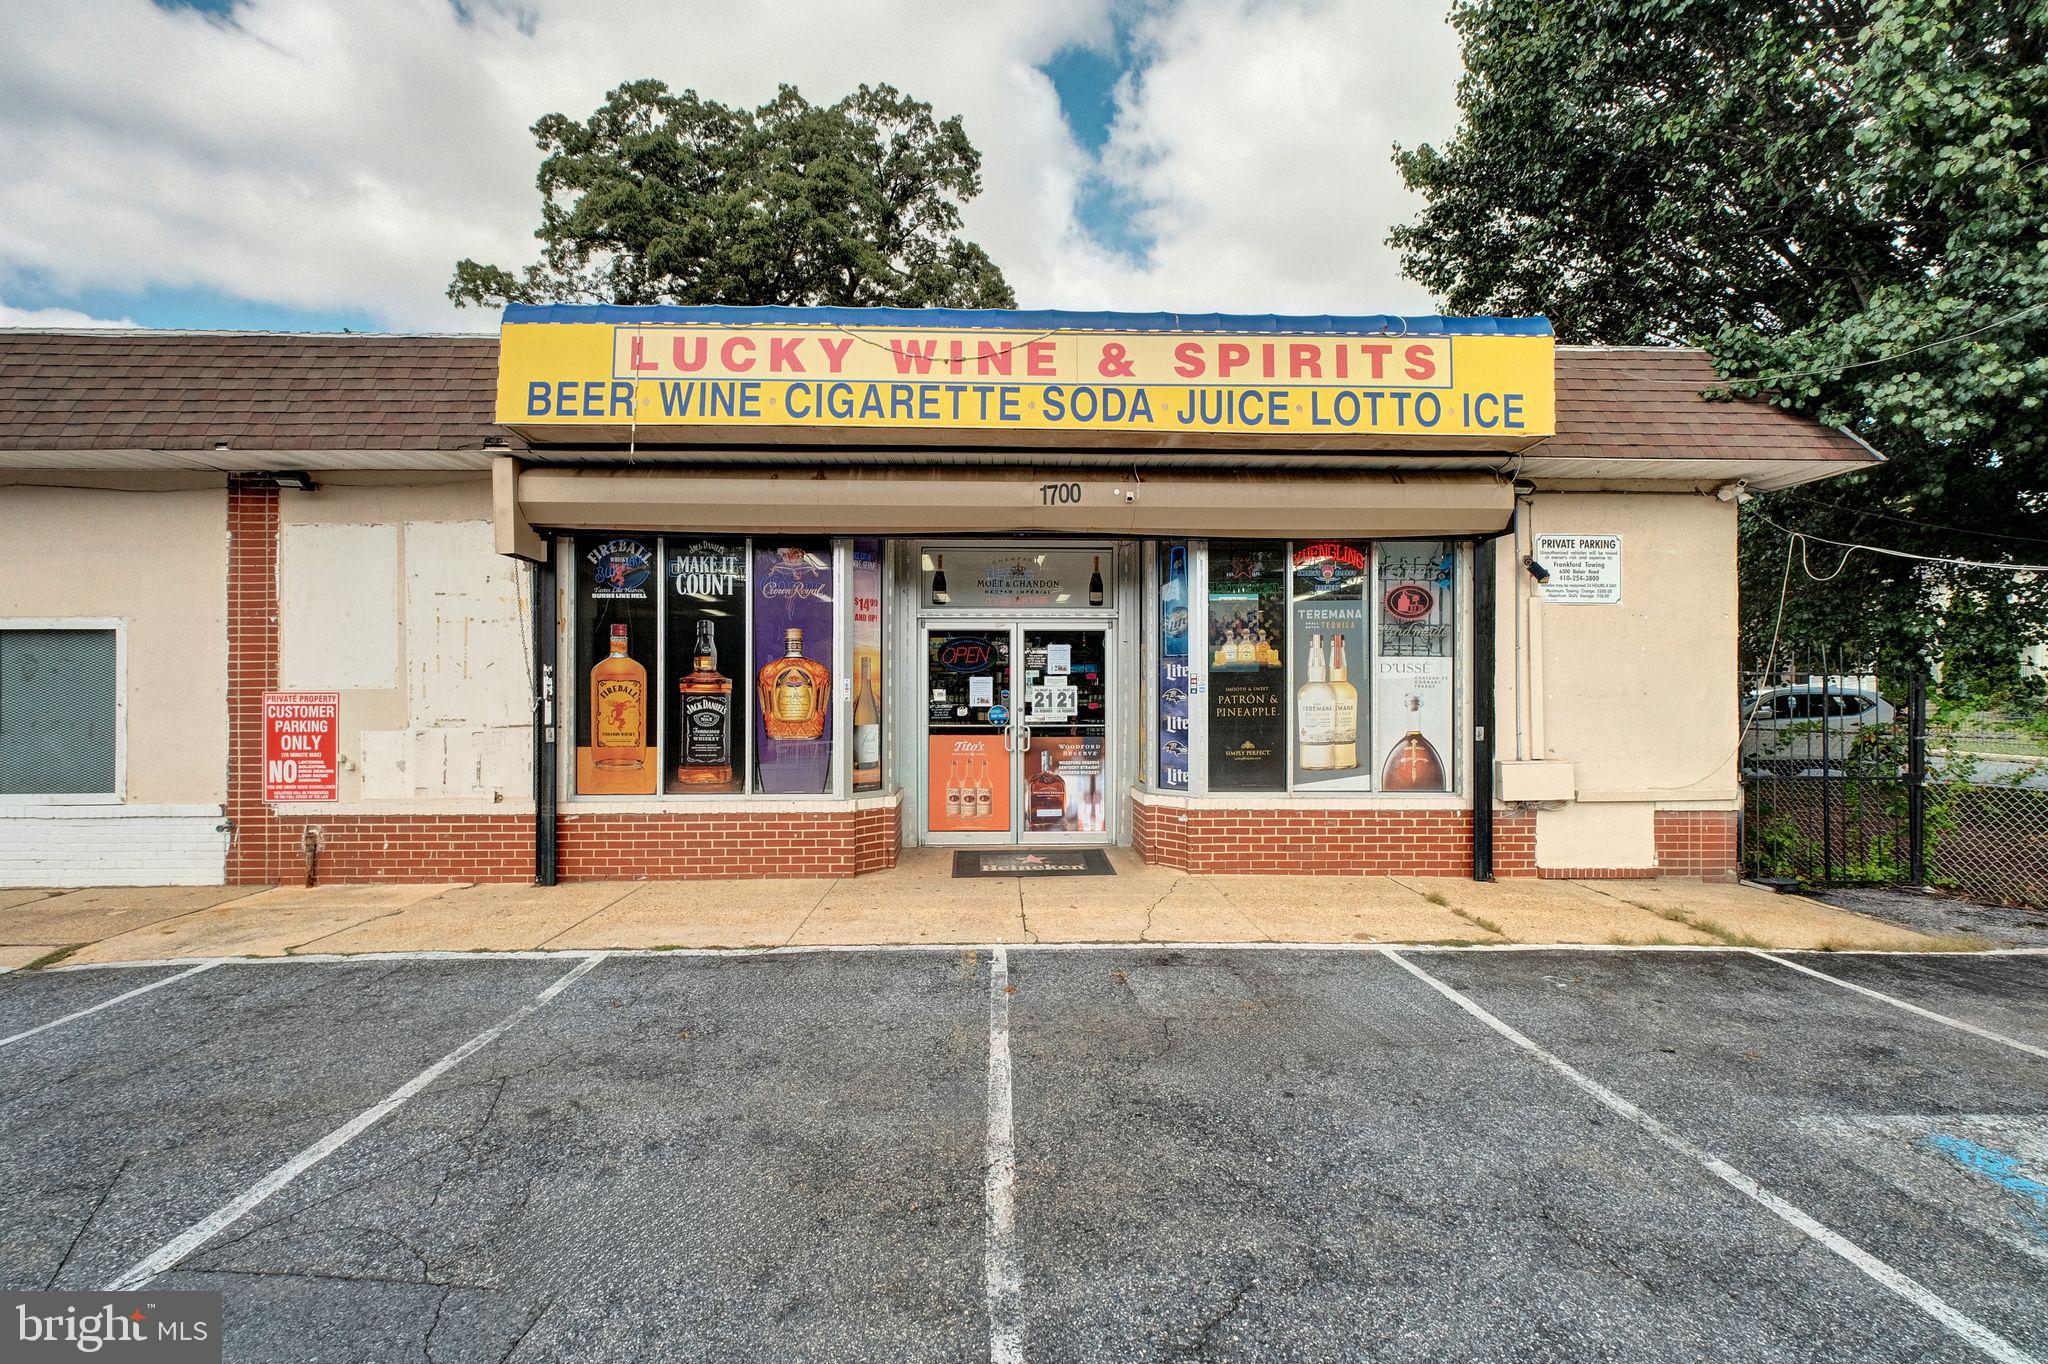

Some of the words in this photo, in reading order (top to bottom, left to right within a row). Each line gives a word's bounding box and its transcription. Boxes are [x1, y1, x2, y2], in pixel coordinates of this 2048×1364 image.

[630, 336, 855, 374] LUCKY
[890, 340, 1057, 376] WINE
[1098, 342, 1136, 378] &
[1173, 342, 1437, 380] SPIRITS
[527, 381, 634, 417] BEER
[659, 382, 762, 418] WINE
[784, 383, 1021, 421] CIGARETTE
[1042, 385, 1154, 423] SODA
[1176, 389, 1290, 426] JUICE
[1311, 390, 1442, 428] LOTTO
[1463, 392, 1525, 429] ICE
[1039, 483, 1082, 506] 1700
[1541, 539, 1576, 549] PRIVATE
[1579, 539, 1616, 549] PARKING
[586, 541, 653, 565] FIREBALL
[1293, 543, 1365, 569] YUENGLING
[677, 555, 718, 573] MAKE
[720, 556, 738, 573] IT
[676, 573, 735, 596] COUNT
[763, 582, 792, 599] Crown
[785, 581, 826, 599] Royal
[1012, 580, 1060, 588] CHANDON
[854, 613, 867, 622] AND
[1321, 621, 1355, 629] TEQUILA
[942, 646, 991, 664] OPEN
[1166, 664, 1188, 681] Lite
[266, 695, 297, 703] PRIVATE
[299, 695, 336, 703] PROPERTY
[600, 685, 640, 699] FIREBALL
[1034, 692, 1052, 708] 21
[1057, 692, 1075, 708] 21
[1218, 693, 1265, 704] PATRÓN
[1270, 694, 1278, 703] &
[268, 705, 335, 718] CUSTOMER
[686, 701, 703, 714] JACK
[702, 699, 728, 715] DANIEL'S
[1216, 707, 1280, 717] PINEAPPLE.
[275, 720, 328, 733] PARKING
[1166, 716, 1188, 733] Lite
[281, 735, 322, 751] ONLY
[954, 741, 985, 752] Tito's
[269, 760, 297, 783] NO
[1166, 768, 1188, 785] Lite
[981, 864, 1086, 872] Heineken
